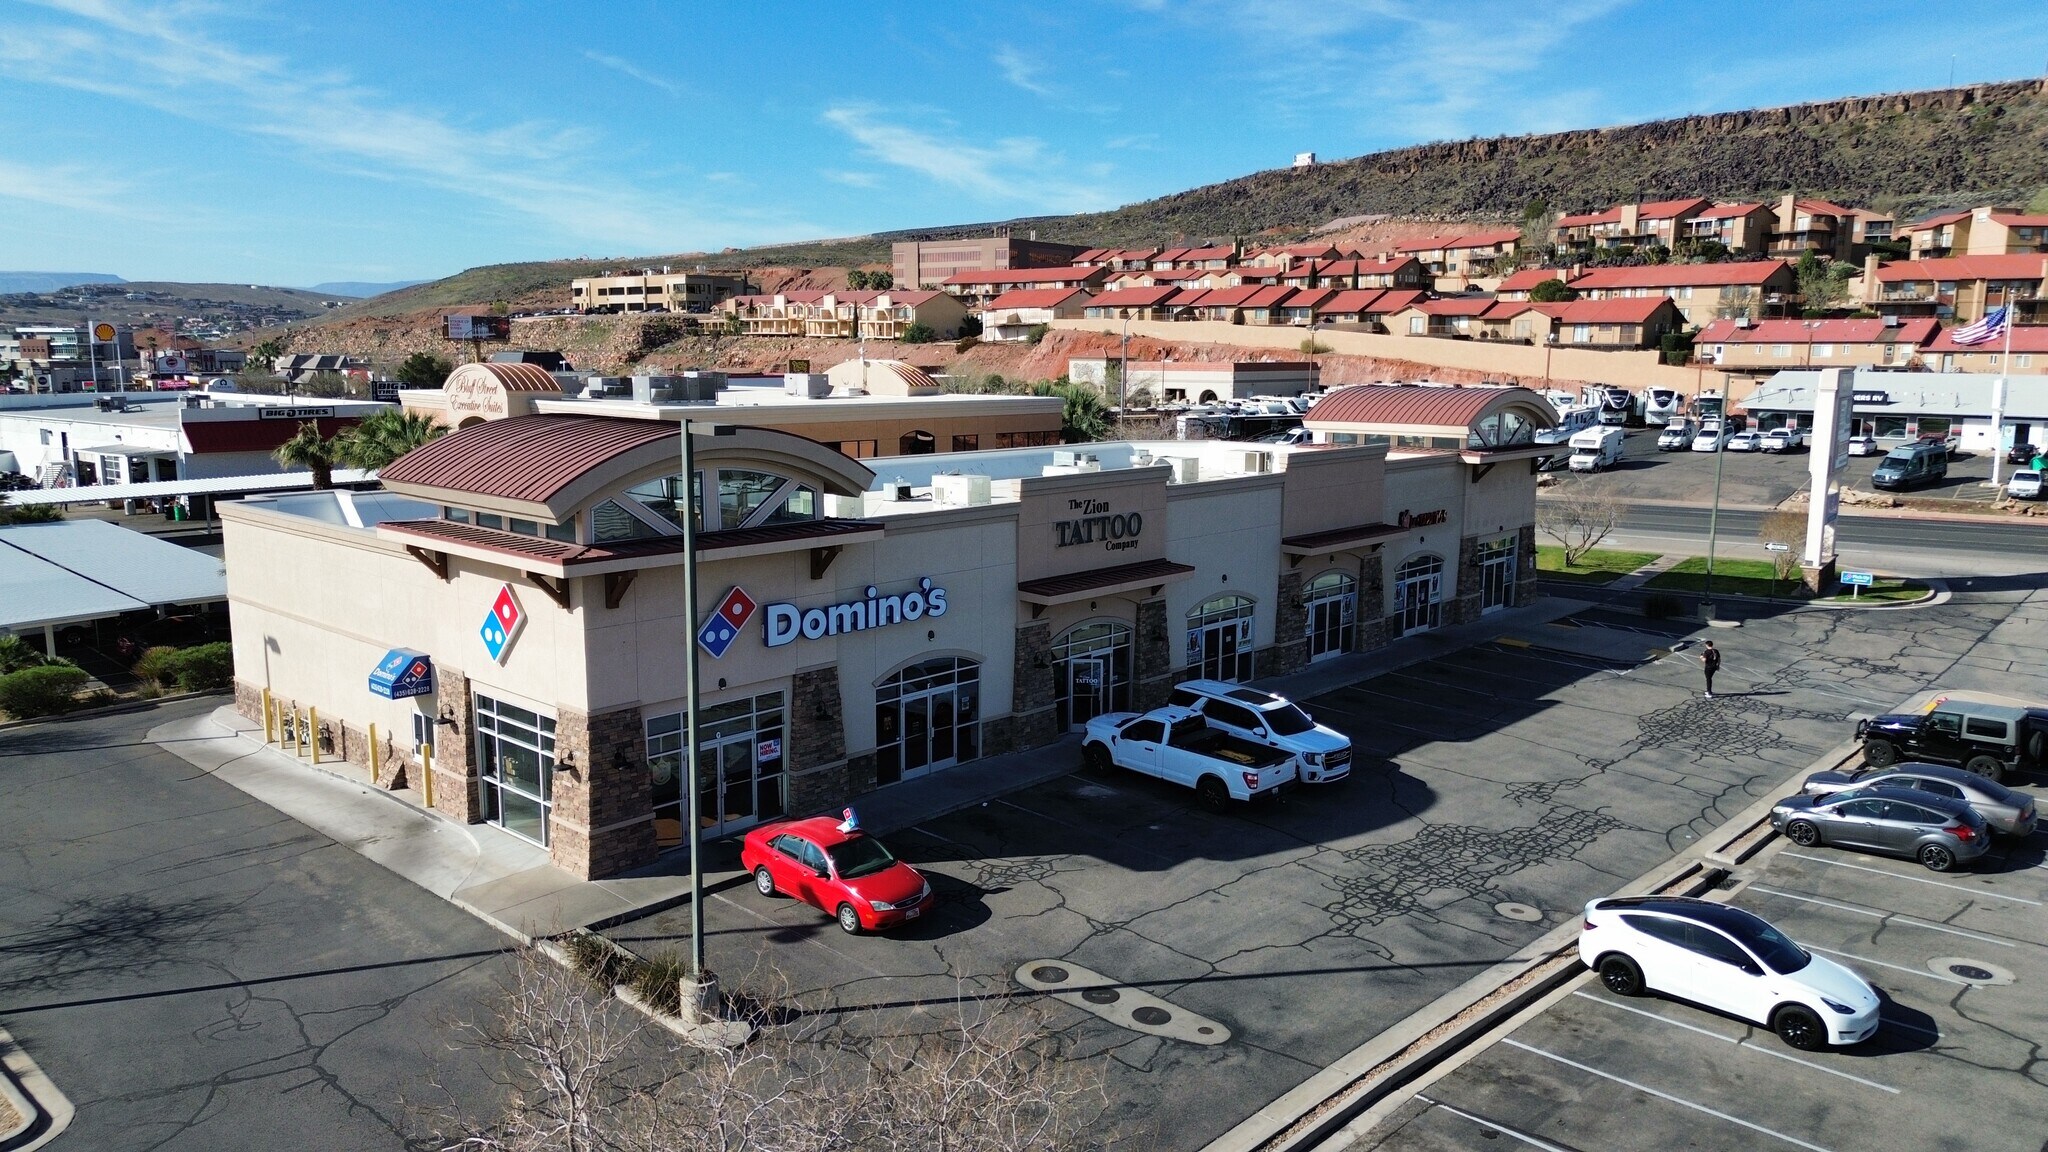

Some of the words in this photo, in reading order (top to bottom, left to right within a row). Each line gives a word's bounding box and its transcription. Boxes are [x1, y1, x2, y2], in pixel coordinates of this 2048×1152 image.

[378, 382, 399, 390] BIG
[477, 376, 498, 395] Street
[450, 394, 481, 412] Executive
[483, 396, 503, 414] Suites
[296, 408, 329, 416] TIRES
[1068, 499, 1082, 510] The
[1083, 499, 1110, 515] Zion
[1054, 512, 1142, 548] TATTOO
[1105, 539, 1139, 551] Company
[764, 576, 948, 647] Domino's
[373, 667, 396, 681] Domino's
[760, 742, 772, 750] NOW
